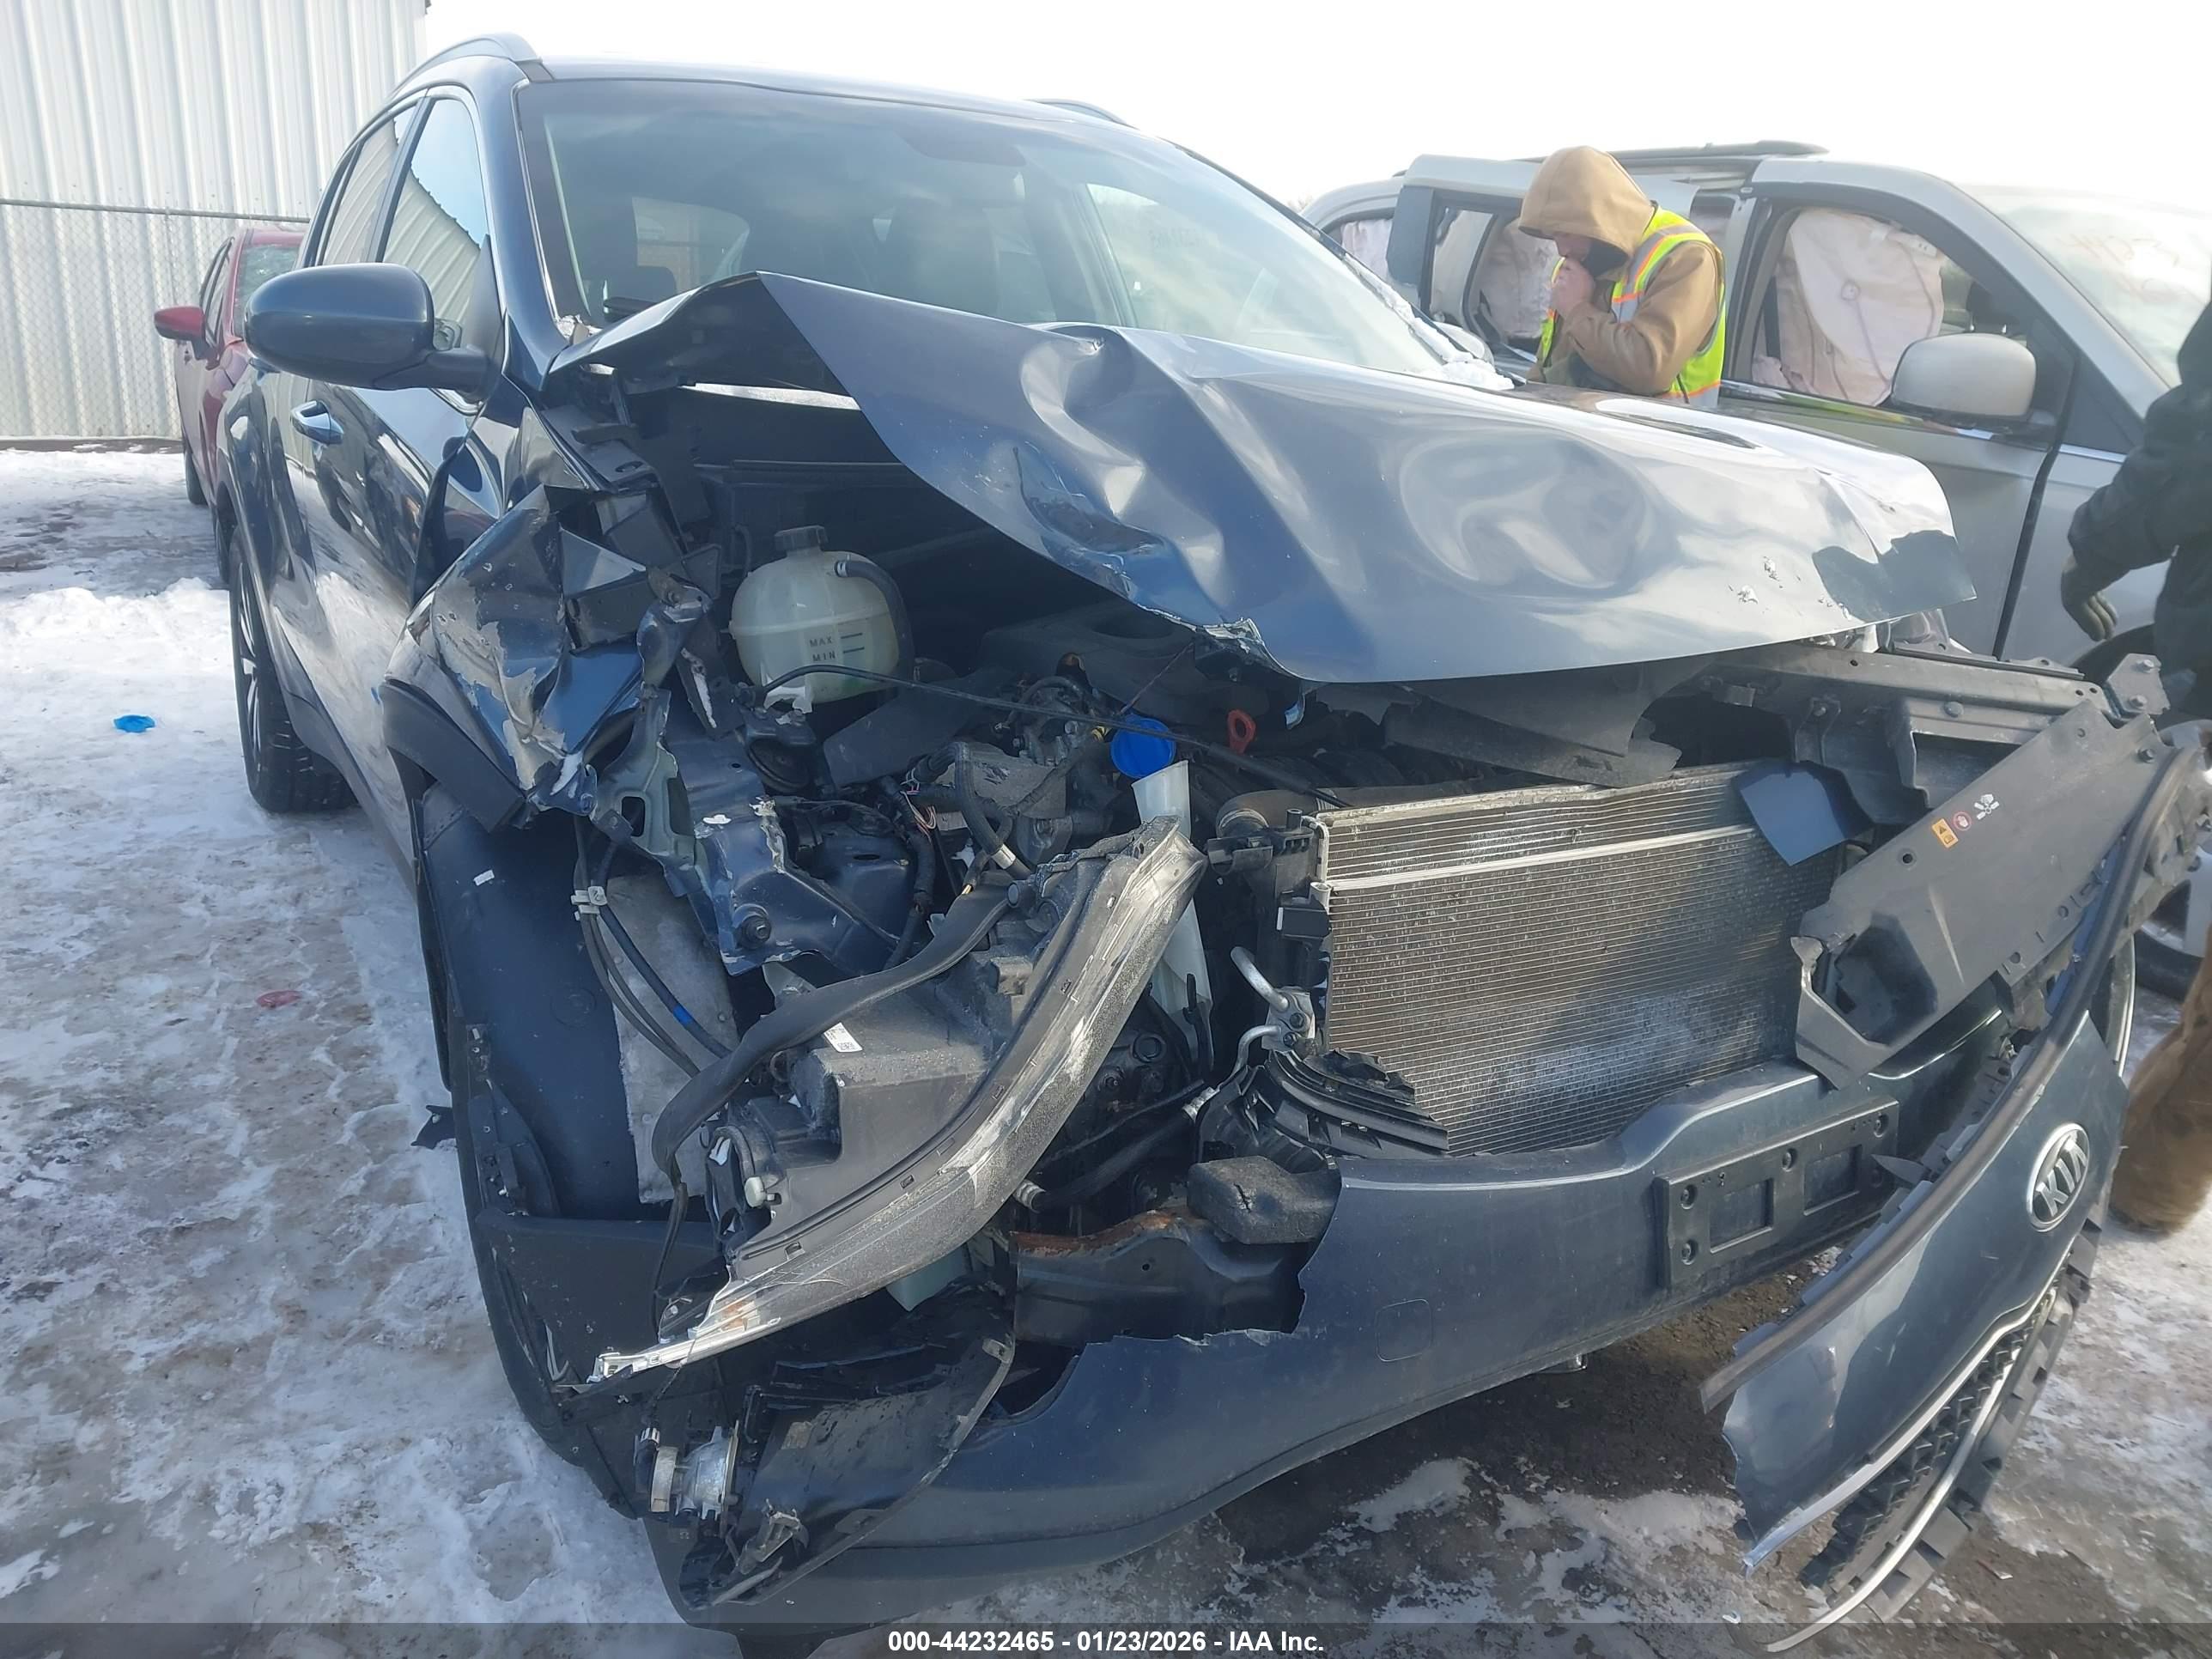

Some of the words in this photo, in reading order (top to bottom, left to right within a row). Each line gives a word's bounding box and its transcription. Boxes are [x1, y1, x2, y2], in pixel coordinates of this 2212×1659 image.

[810, 635, 832, 647] MAX
[812, 650, 836, 661] MIN
[2035, 1139, 2088, 1218] KIA
